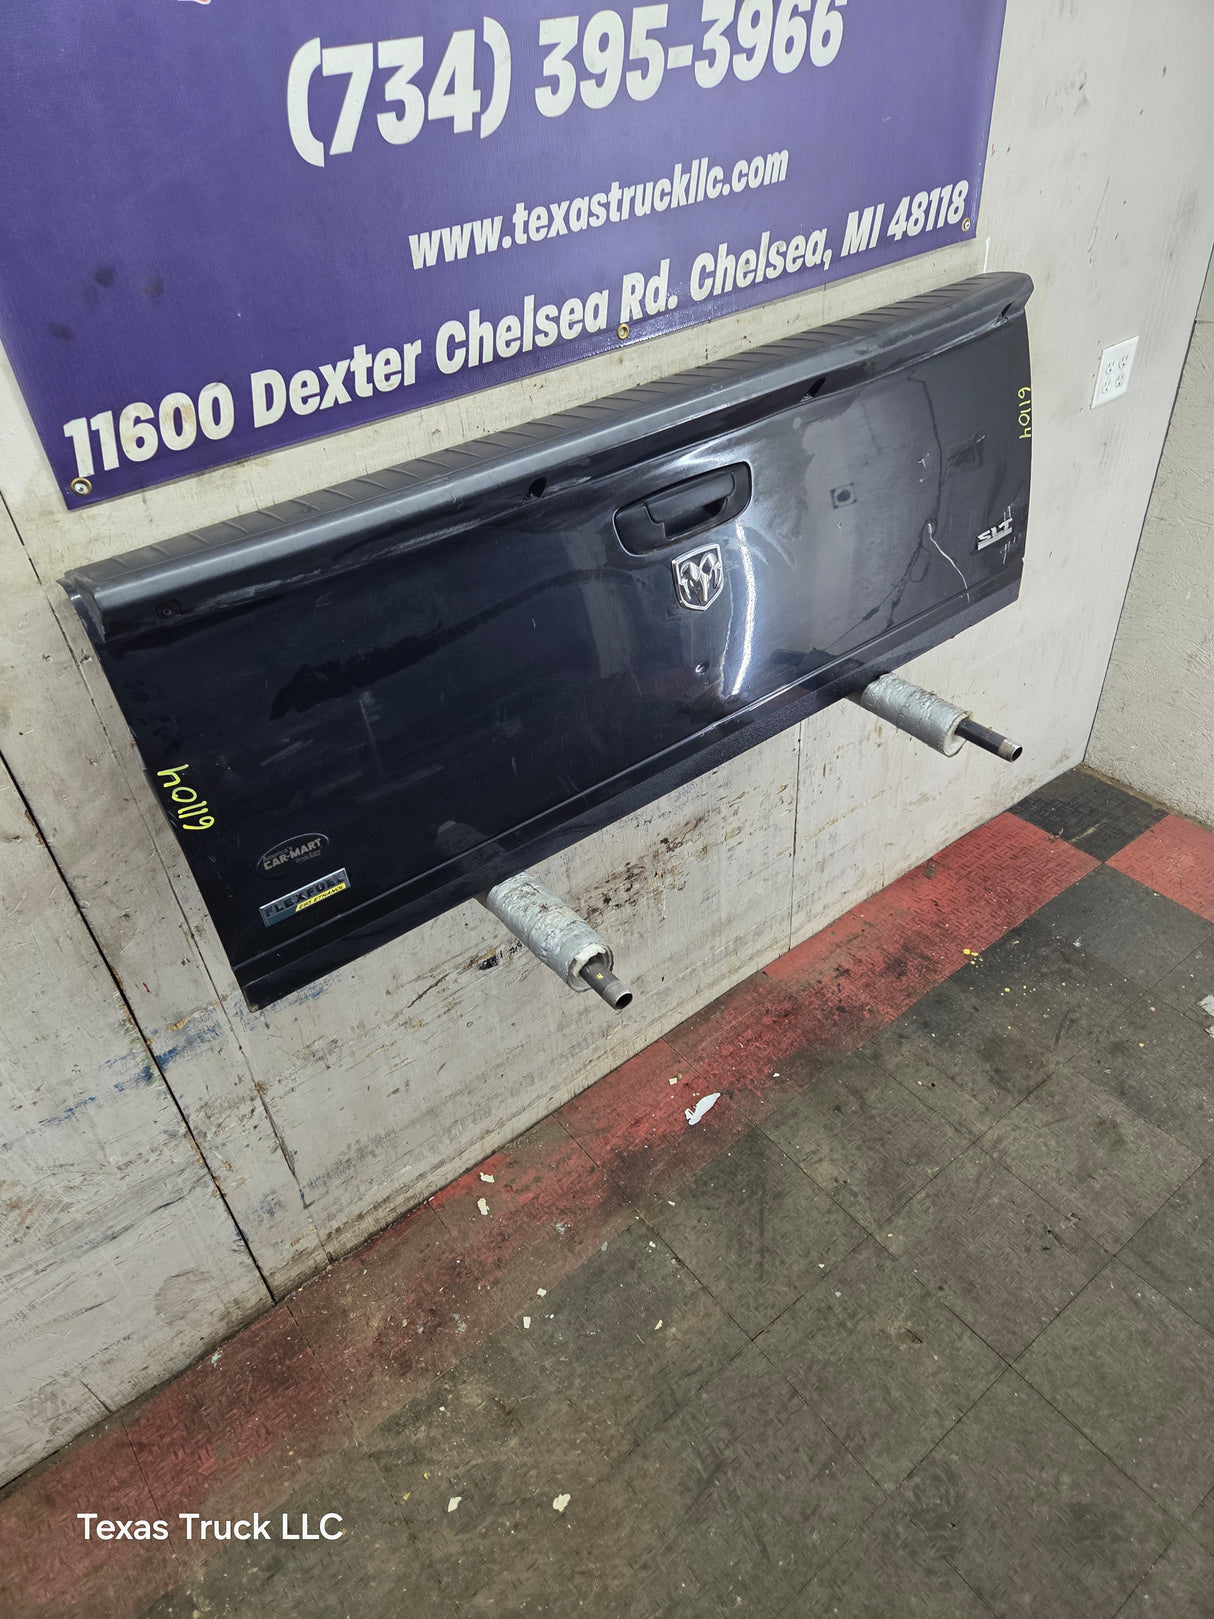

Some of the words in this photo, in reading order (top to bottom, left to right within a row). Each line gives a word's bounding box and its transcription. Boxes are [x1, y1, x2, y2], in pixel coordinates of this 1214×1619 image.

[287, 15, 512, 168] (734)
[535, 0, 848, 120] 395-3966
[408, 149, 790, 271] www.texastruckllc.com
[63, 382, 235, 479] 11600
[251, 340, 422, 429] Dexter
[436, 289, 609, 375] Chelsea
[619, 258, 679, 324] Rd.
[687, 228, 833, 302] Chelsea,
[840, 203, 886, 258] MI
[887, 180, 969, 242] 48118
[977, 517, 1013, 542] SLT
[263, 838, 322, 870] CAR-MART
[265, 872, 346, 918] FLEXFUEL
